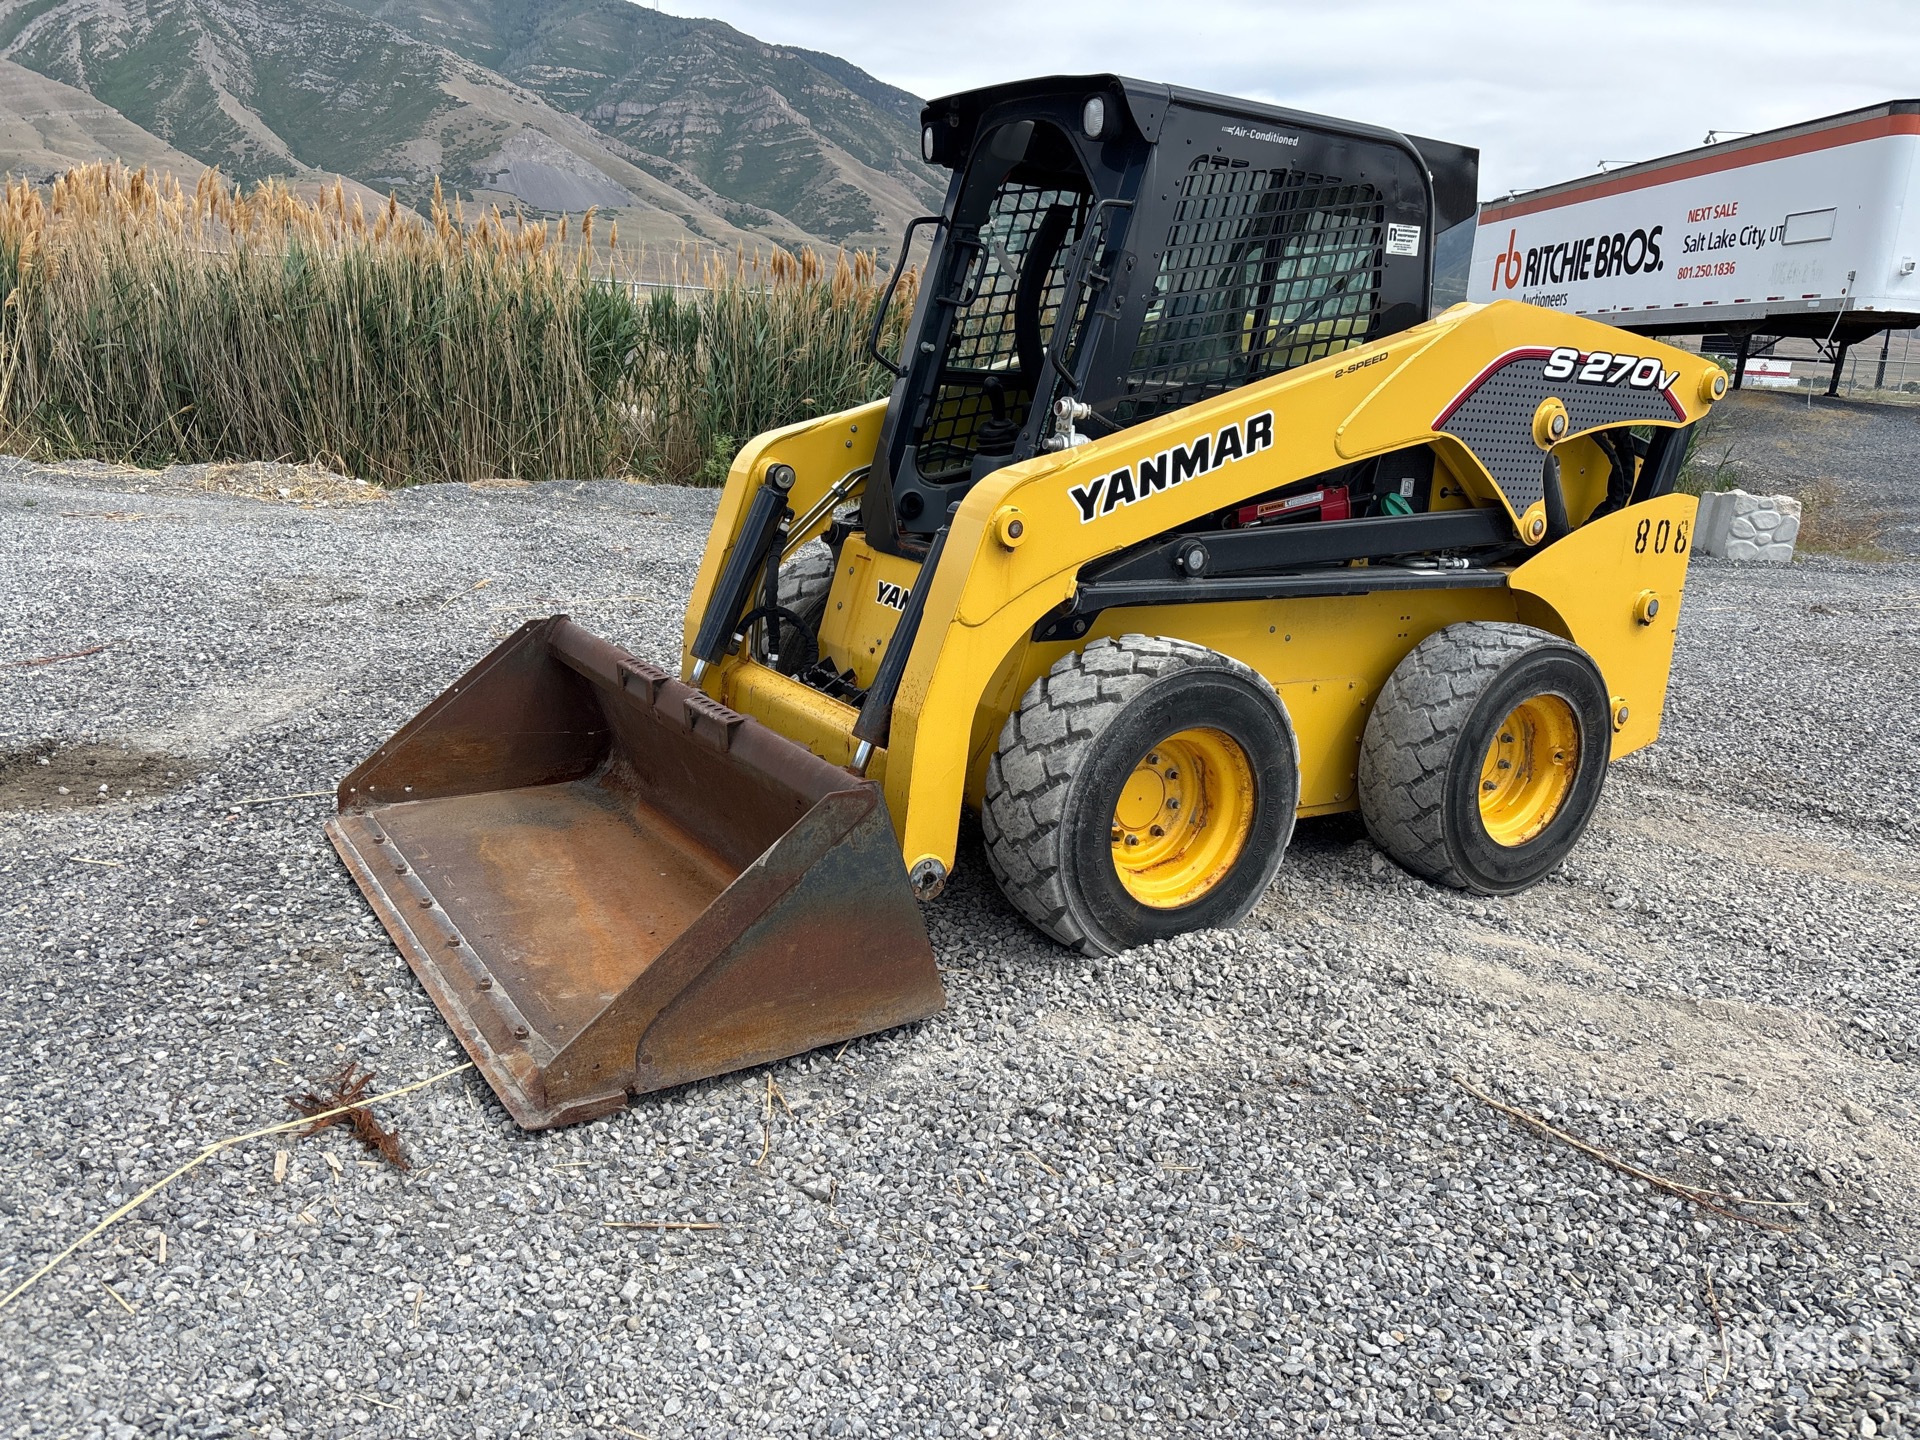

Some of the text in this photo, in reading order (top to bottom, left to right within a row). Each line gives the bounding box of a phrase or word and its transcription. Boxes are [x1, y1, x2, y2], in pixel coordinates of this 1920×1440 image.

[1234, 126, 1299, 146] Air-Conditioned
[1687, 202, 1738, 223] NEXT SALE
[1683, 225, 1784, 253] Salt Lake City, UT
[1492, 225, 1664, 291] rb RITCHIE BROS.
[1677, 262, 1736, 279] 801.250.1836
[1521, 291, 1568, 307] Auctioneers
[1335, 352, 1388, 378] 2-SPEED
[1069, 411, 1274, 523] YANMAR
[1634, 518, 1689, 554] 808
[876, 580, 911, 611] YAN
